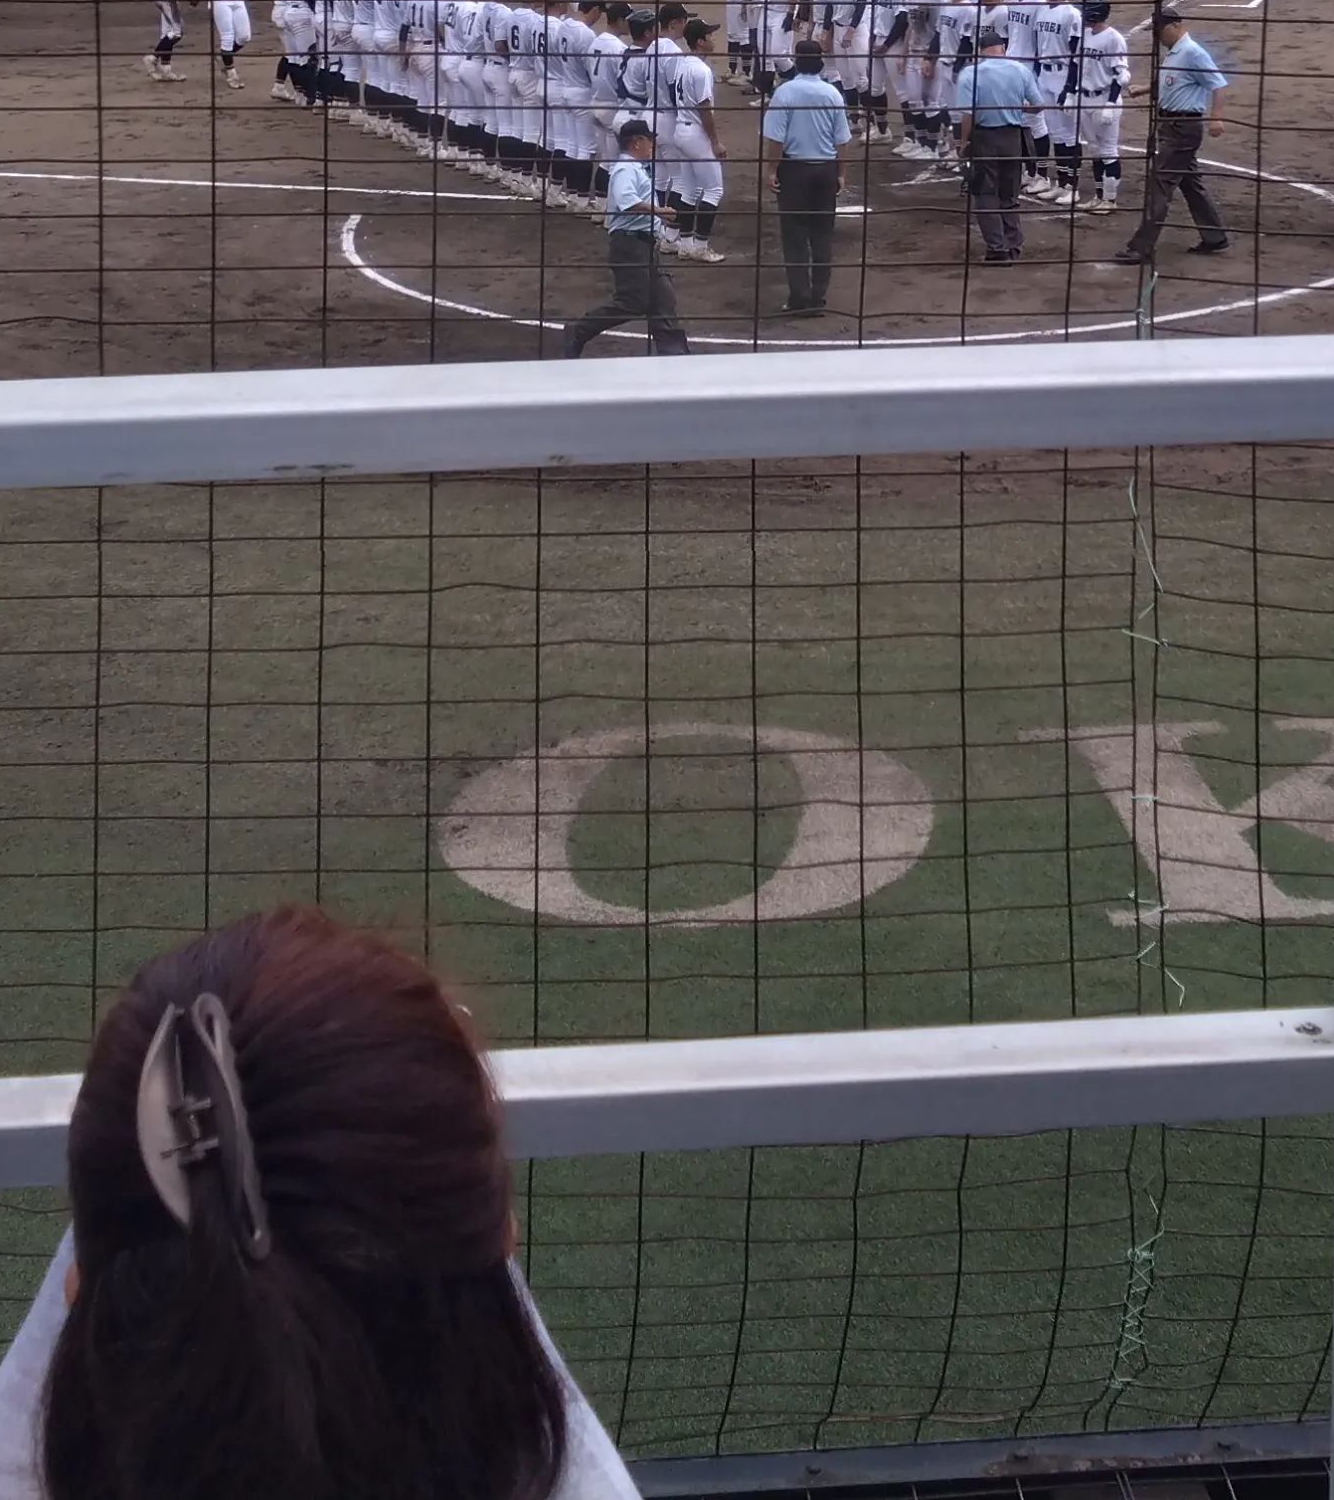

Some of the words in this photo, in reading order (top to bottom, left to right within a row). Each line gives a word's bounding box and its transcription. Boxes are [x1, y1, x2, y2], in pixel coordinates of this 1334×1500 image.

[411, 3, 424, 28] 11
[511, 25, 520, 50] 6
[594, 49, 602, 76] 7
